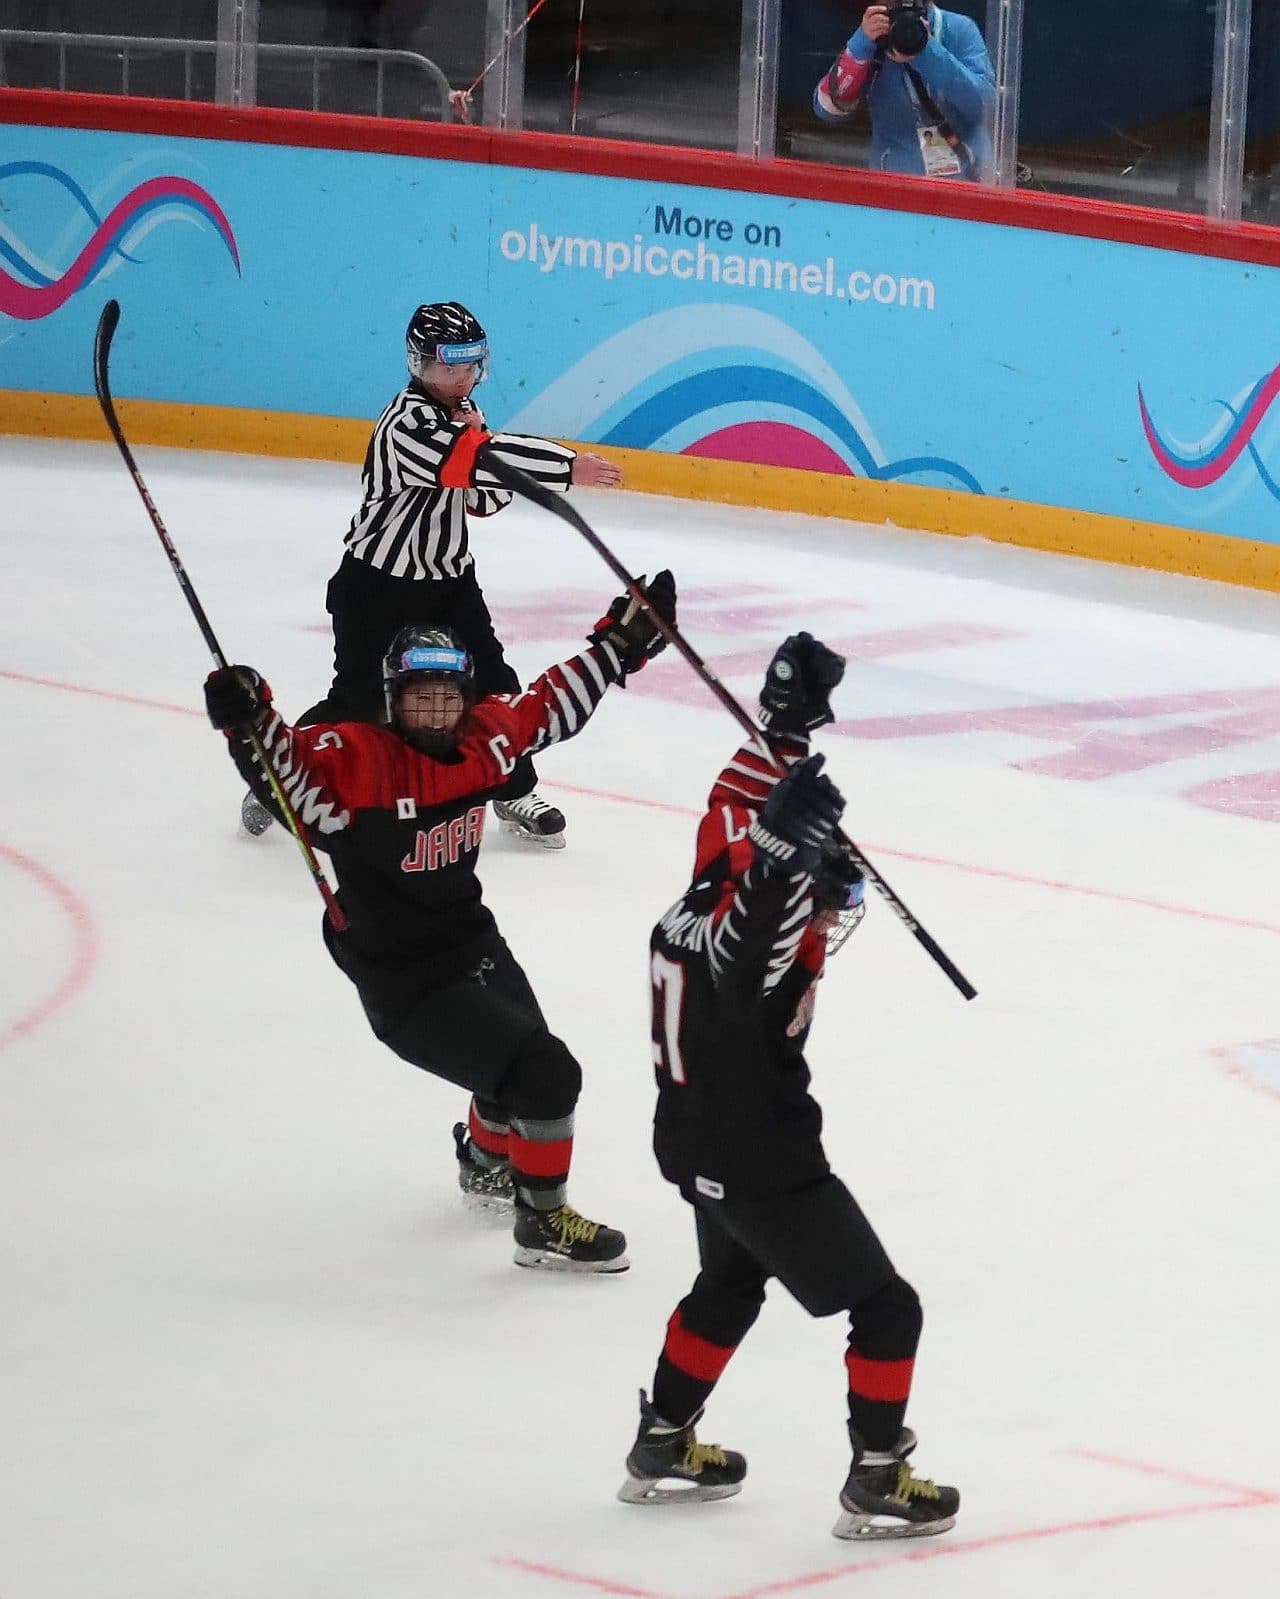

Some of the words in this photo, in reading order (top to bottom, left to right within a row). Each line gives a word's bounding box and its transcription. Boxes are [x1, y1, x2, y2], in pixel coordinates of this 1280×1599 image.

[654, 205, 734, 242] More
[744, 220, 782, 248] on
[500, 223, 936, 311] olympicchannel.com
[488, 734, 517, 775] C
